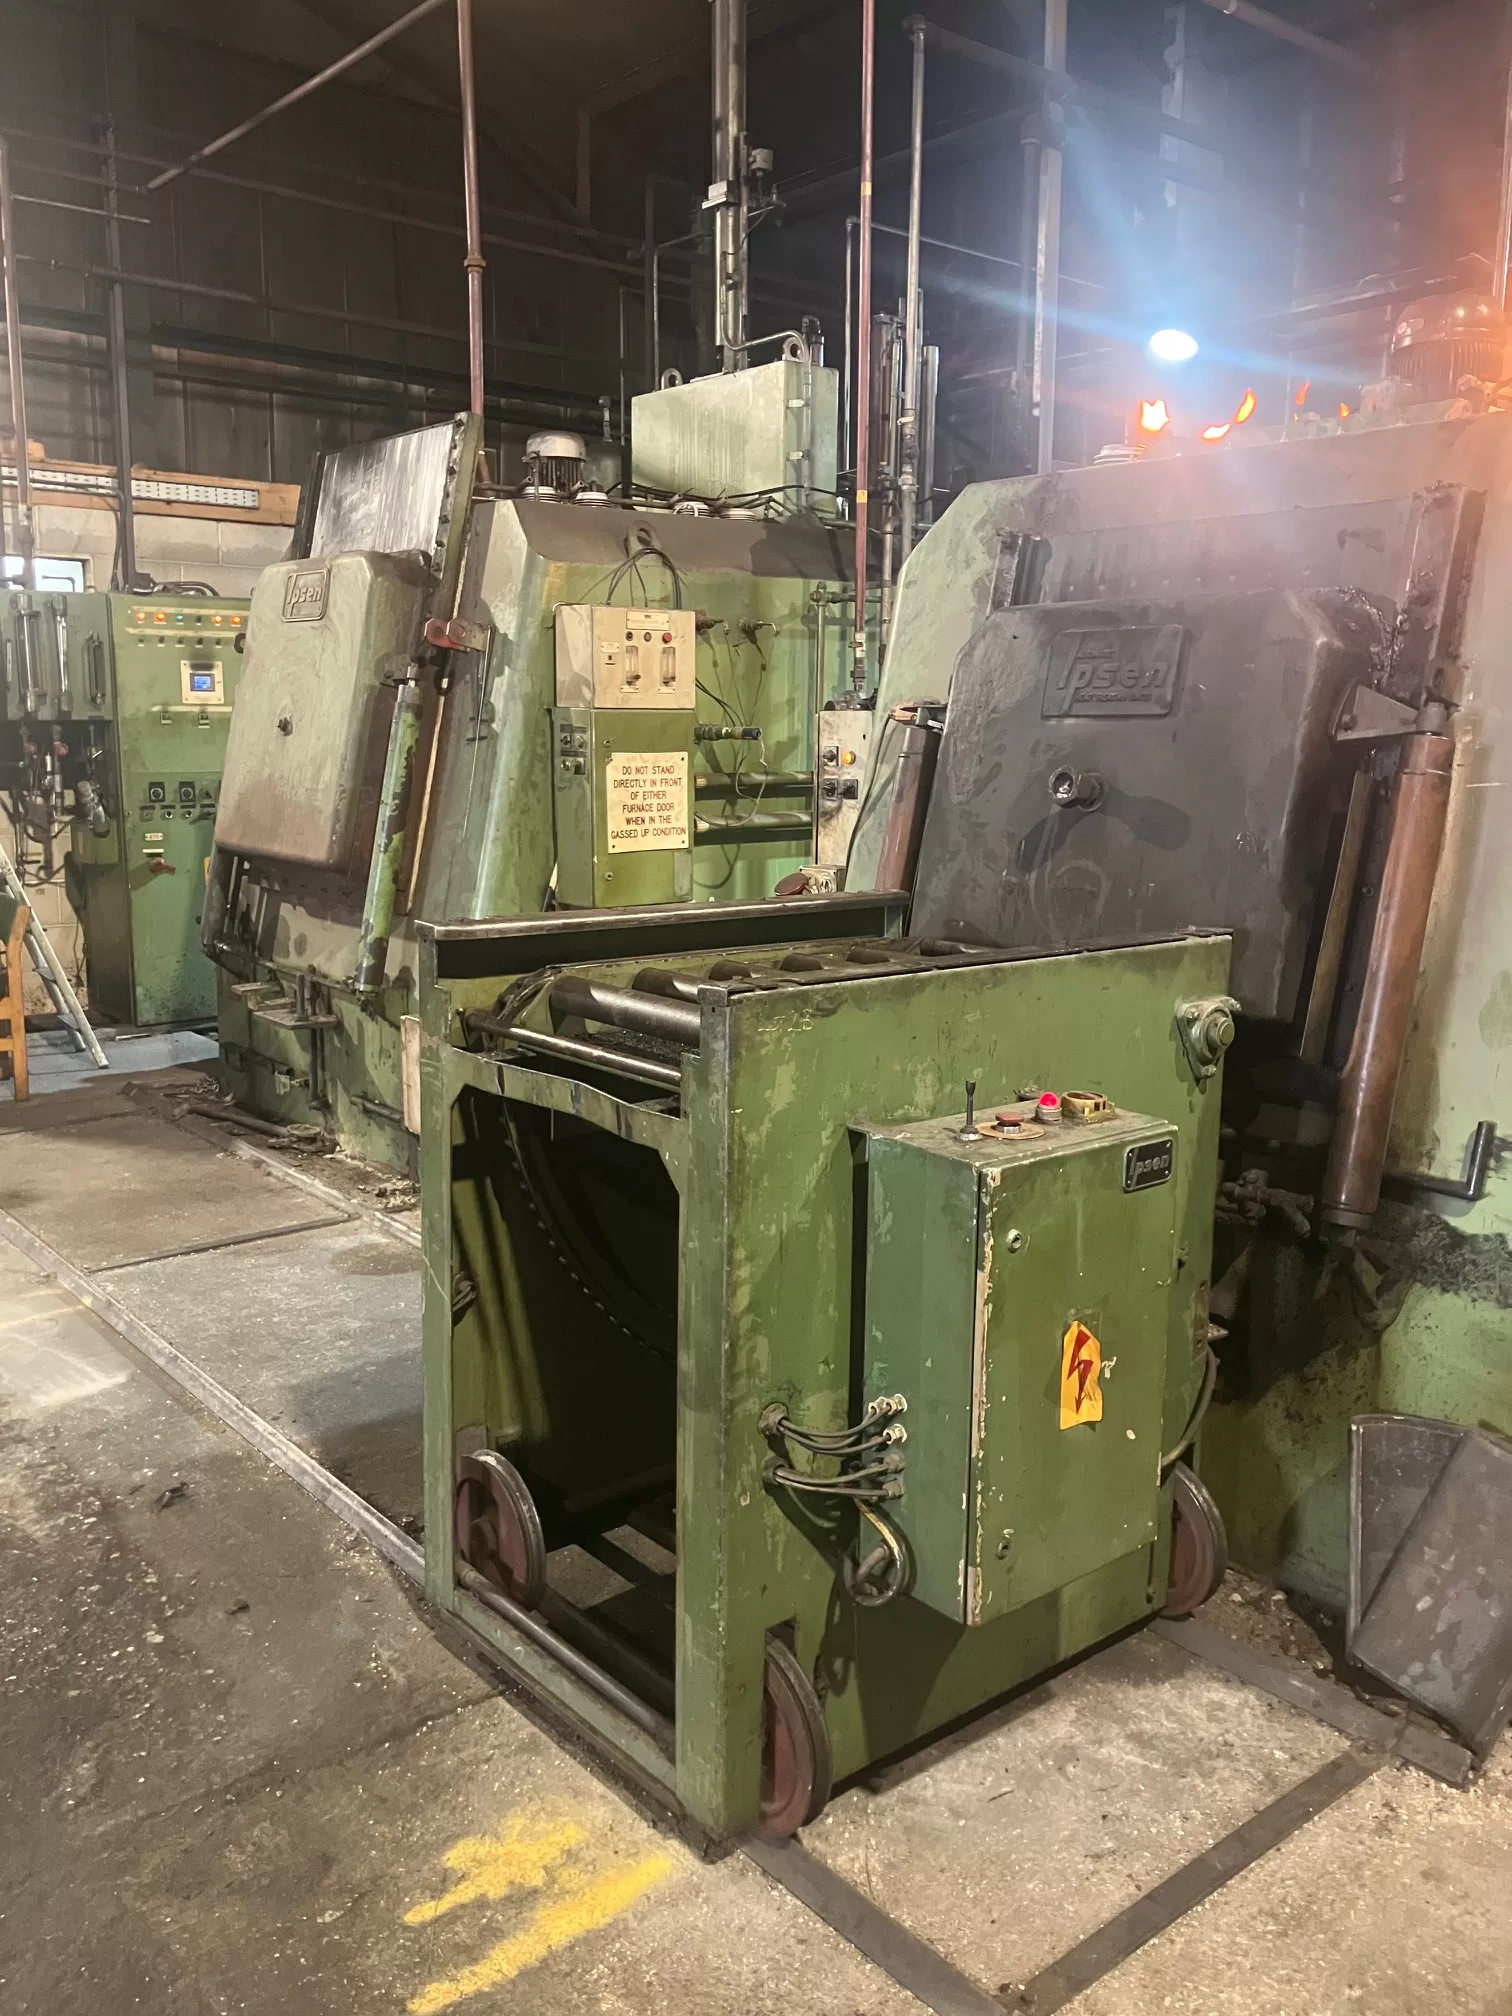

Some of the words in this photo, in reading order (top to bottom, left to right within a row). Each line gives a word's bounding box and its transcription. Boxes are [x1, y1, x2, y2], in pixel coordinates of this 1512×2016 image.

[287, 573, 324, 617] Ipsen
[1056, 631, 1169, 714] Ipsen
[622, 766, 632, 775] DO
[635, 766, 648, 775] NOT
[652, 765, 675, 775] STAND
[613, 779, 647, 789] DIRECTLY
[650, 778, 657, 787] IN
[660, 777, 682, 787] FRONT
[630, 791, 639, 800] OF
[642, 790, 667, 800] EITHER
[622, 803, 654, 813] FURNACE
[656, 803, 675, 812] DOOR
[625, 816, 645, 826] WHEN
[648, 816, 655, 824] IN
[658, 815, 672, 824] THE
[611, 829, 638, 839] GASSED
[640, 828, 650, 837] UP
[652, 826, 687, 837] CONDITION
[1129, 1146, 1170, 1189] Ipsen
